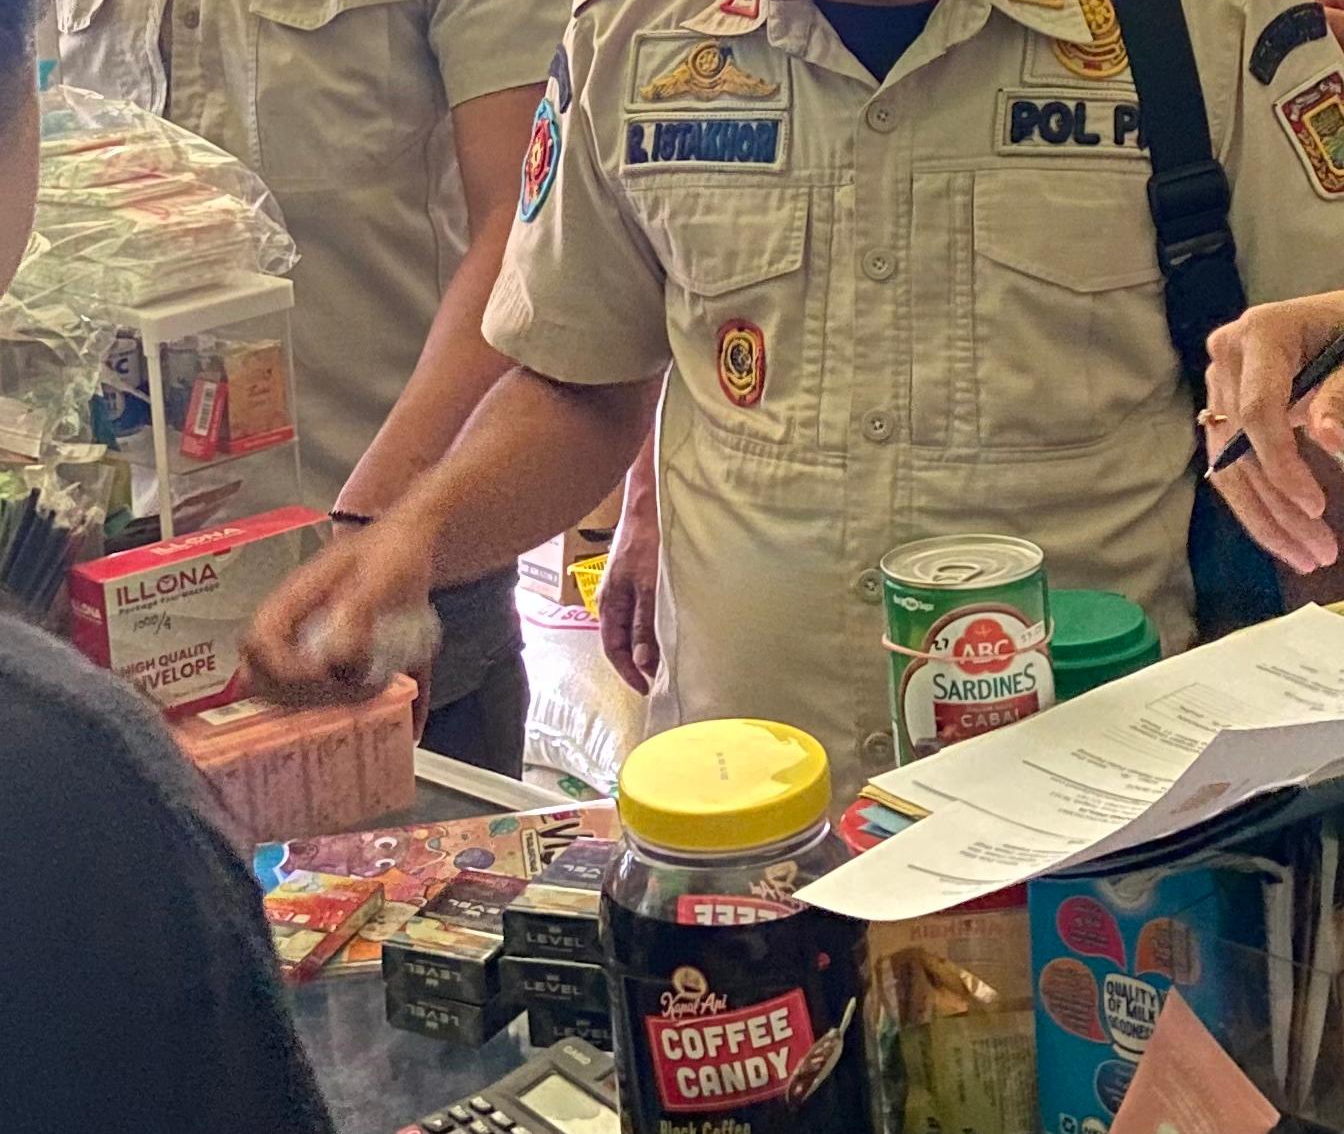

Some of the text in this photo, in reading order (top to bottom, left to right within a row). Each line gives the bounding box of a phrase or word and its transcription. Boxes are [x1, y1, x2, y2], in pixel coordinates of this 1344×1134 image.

[1010, 101, 1148, 149] POL P
[149, 527, 247, 556] ILLONA
[115, 563, 219, 608] ILLONA
[158, 640, 214, 667] QUALITY
[959, 638, 1010, 665] ABC
[140, 654, 217, 692] NVELOPE
[932, 662, 1036, 701] SARDINES
[525, 931, 585, 949] LEVEL
[523, 980, 583, 997] LEVEL
[1106, 980, 1156, 1008] QUALITY
[1108, 996, 1122, 1012] OF
[660, 1006, 794, 1061] COFFEE
[676, 1046, 790, 1099] CANDY
